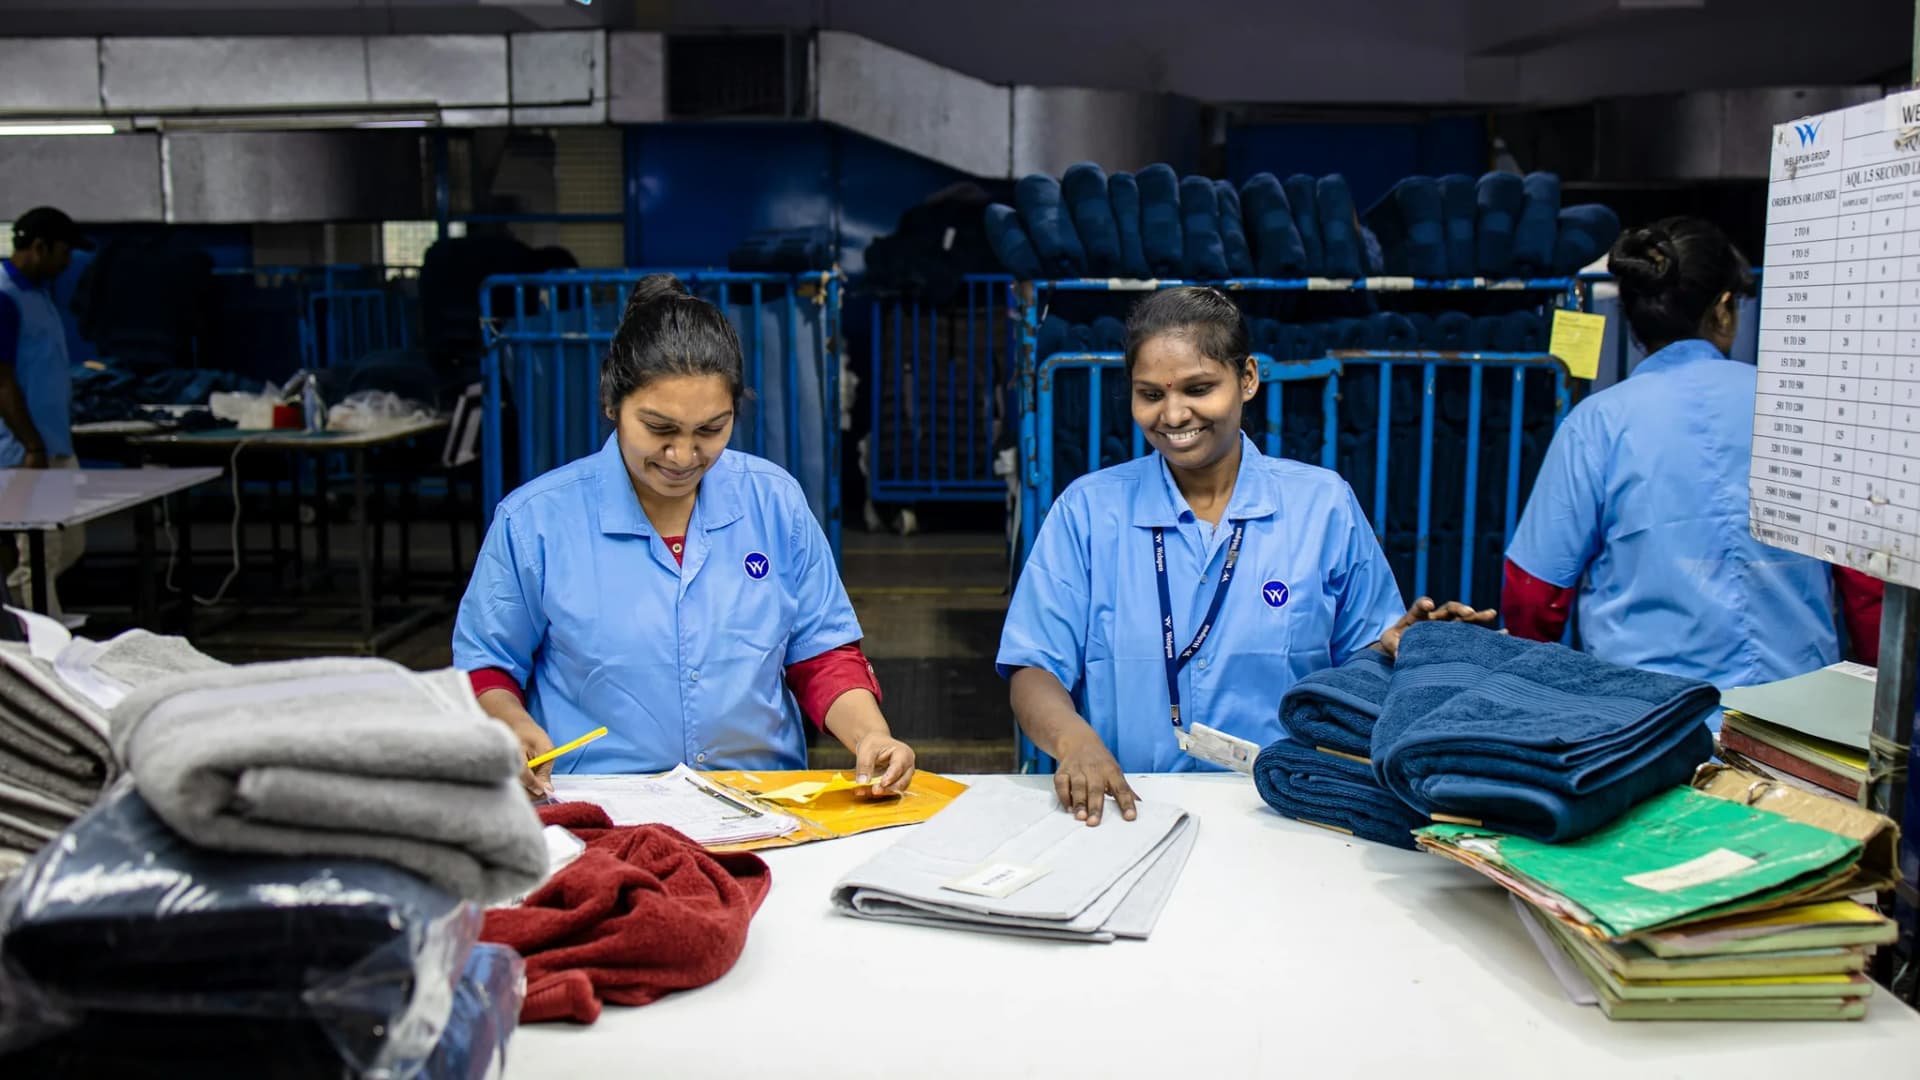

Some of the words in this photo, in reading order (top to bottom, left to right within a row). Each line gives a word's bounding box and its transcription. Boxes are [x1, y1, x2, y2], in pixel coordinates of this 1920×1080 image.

[1846, 172, 1862, 187] AQL
[1875, 163, 1910, 181] SECOND
[1912, 160, 1920, 175] L
[1772, 196, 1791, 207] ORDER
[1784, 534, 1799, 546] OVER
